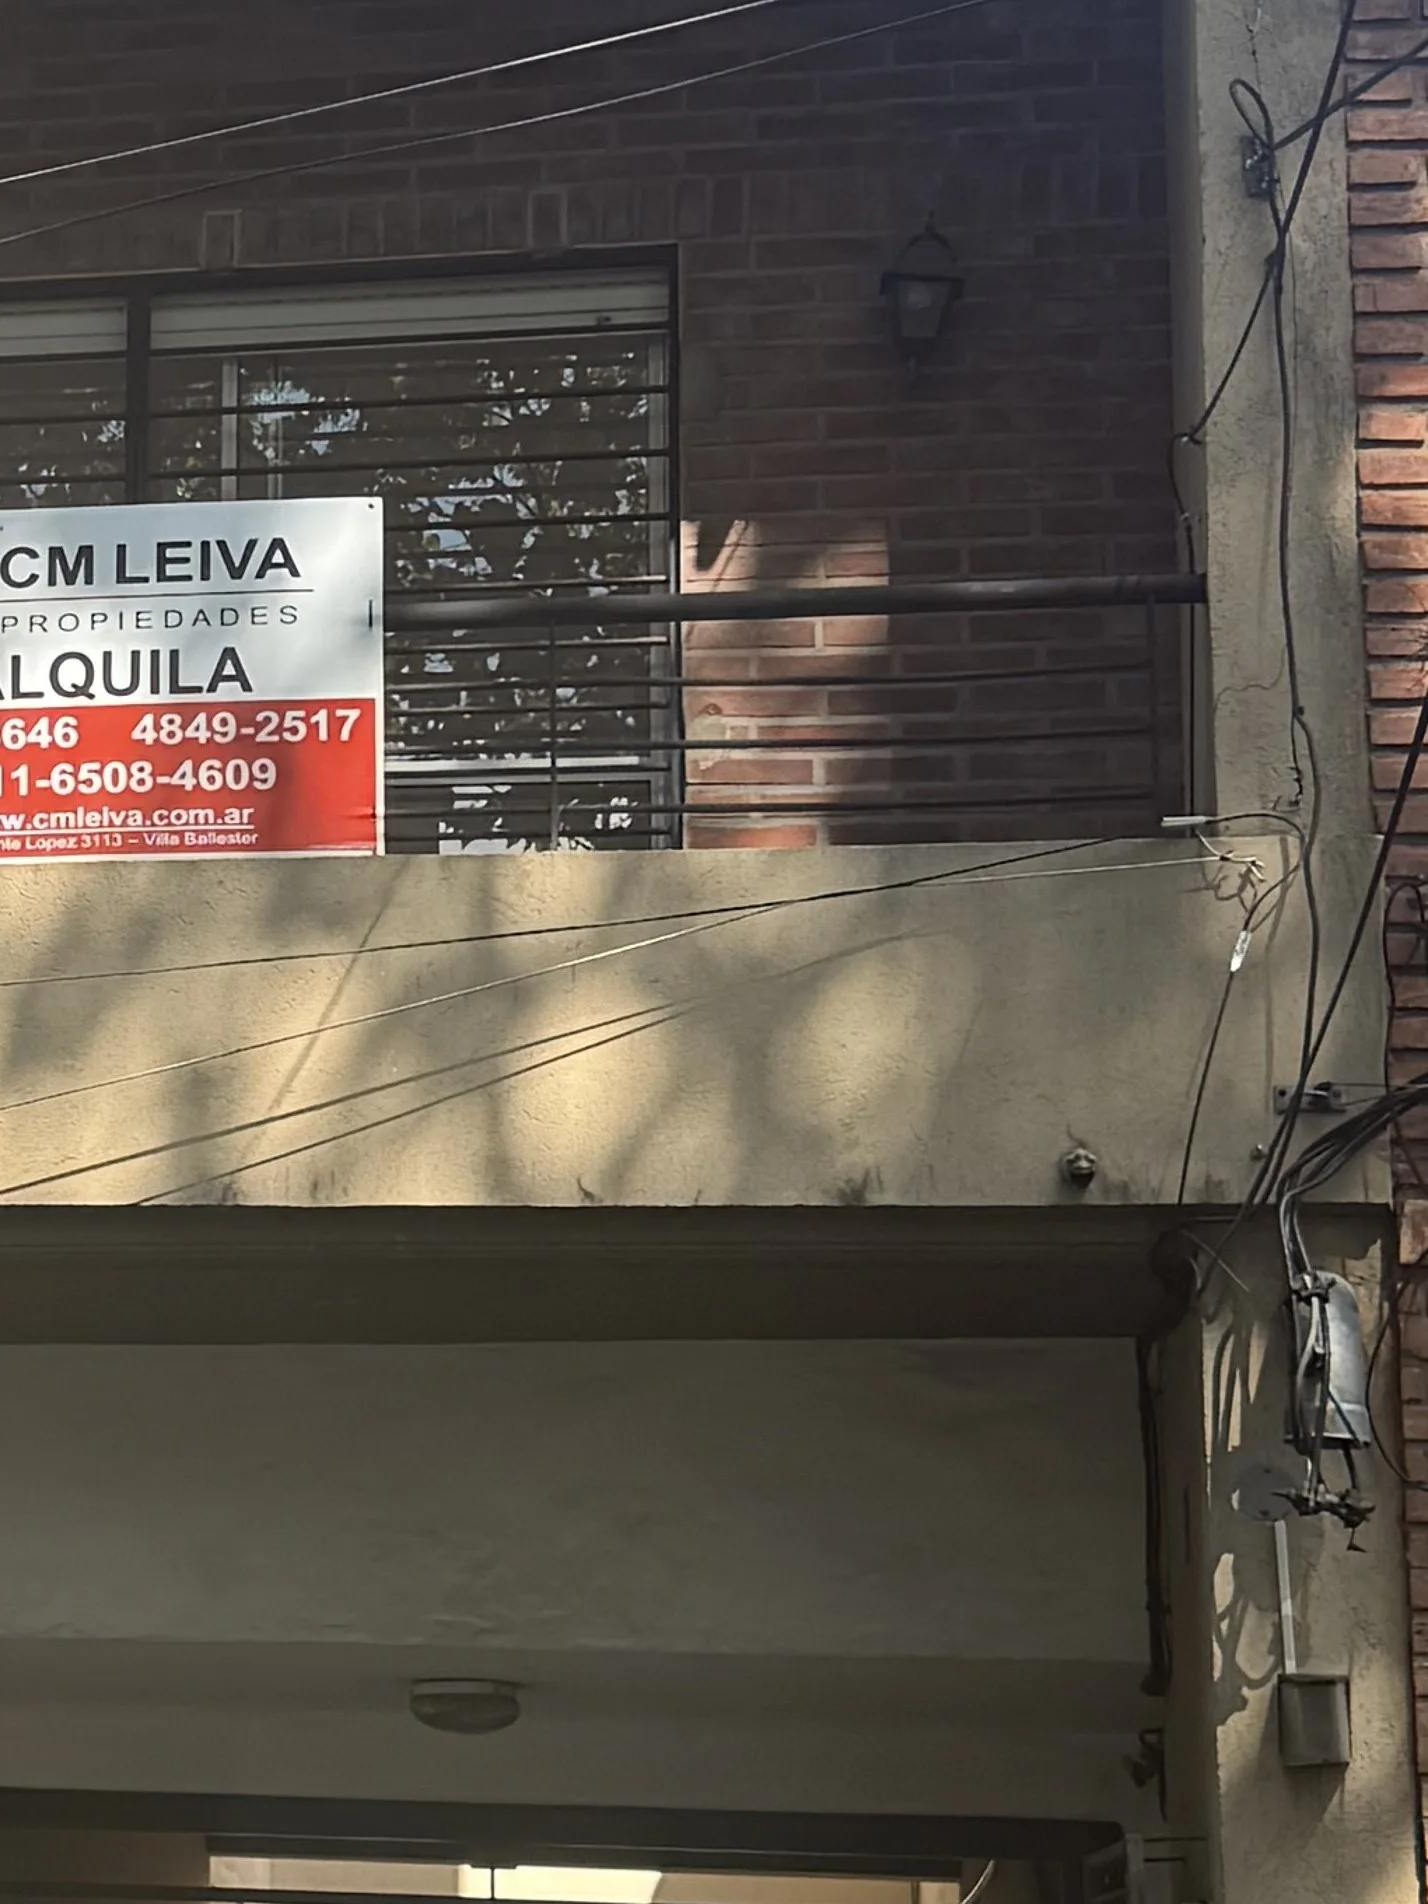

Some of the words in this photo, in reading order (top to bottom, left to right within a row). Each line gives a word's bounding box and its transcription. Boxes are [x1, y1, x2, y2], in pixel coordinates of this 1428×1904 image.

[0, 544, 94, 589] CM
[115, 537, 302, 585] LEIVA
[0, 604, 299, 634] PROPIEDADES
[130, 707, 362, 746] 4849-2517
[81, 833, 123, 849] 3113
[143, 831, 181, 846] Villa
[184, 831, 259, 846] Ballester
